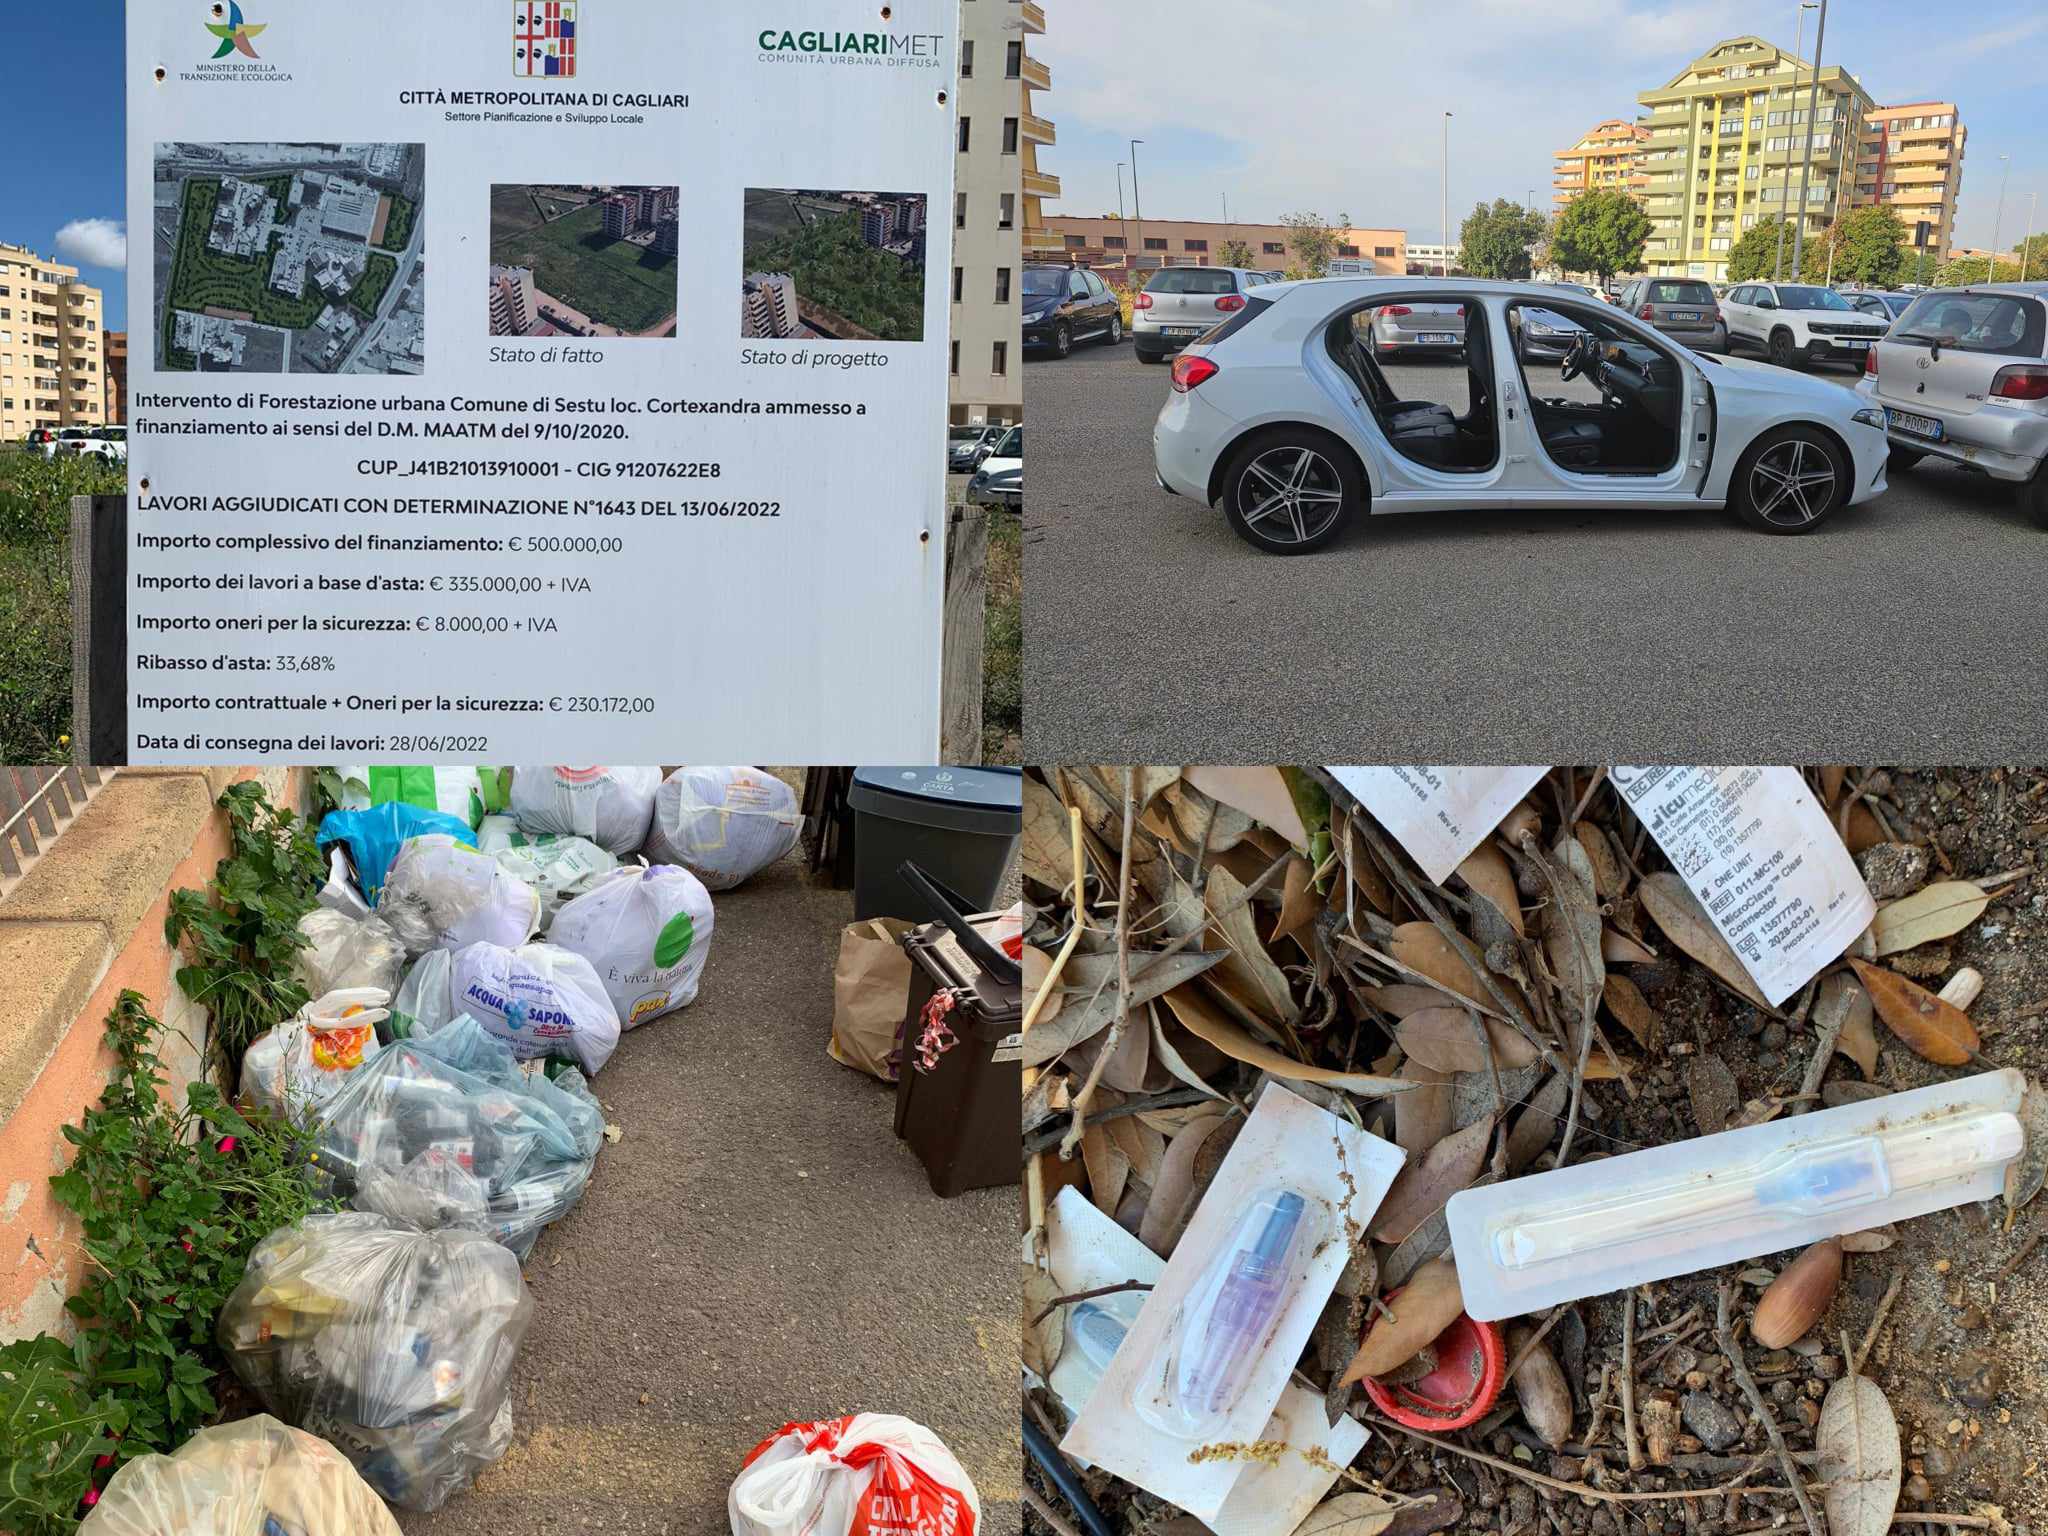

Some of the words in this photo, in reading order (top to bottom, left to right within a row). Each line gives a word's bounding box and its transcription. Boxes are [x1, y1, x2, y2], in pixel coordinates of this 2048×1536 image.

[196, 64, 245, 73] MINISTERO
[247, 64, 277, 73] DELLA
[758, 53, 825, 64] COMUNITÀ
[829, 54, 883, 66] URBANA
[886, 55, 941, 69] DIFFUSA
[180, 73, 239, 82] TRANSIZIONE
[241, 73, 293, 82] ECOLOGICA
[399, 87, 447, 105] CITTÀ
[450, 91, 589, 106] METROPOLITANA
[592, 92, 608, 107] DI
[612, 92, 689, 108] CAGLIARI
[444, 111, 481, 123] Settore
[483, 112, 554, 124] Pianificazione
[556, 114, 562, 123] e
[564, 112, 608, 127] Sviluppo
[610, 113, 645, 125] Locale
[487, 346, 536, 363] Stato
[539, 346, 558, 363] di
[561, 346, 604, 364] fatto
[740, 348, 790, 368] Stato
[791, 348, 809, 366] di
[811, 351, 889, 370] progetto
[135, 391, 233, 409] Intervento
[236, 392, 254, 409] di
[259, 393, 378, 411] Forestazione
[381, 394, 446, 412] urbana
[450, 396, 529, 413] Comune
[532, 396, 550, 413] di
[554, 396, 606, 413] Sestu
[610, 396, 643, 414] loc.
[646, 397, 761, 415] Cortexandra
[764, 402, 852, 416] ammesso
[855, 403, 867, 416] a
[135, 418, 269, 436] finanziamento
[272, 419, 288, 436] ai
[292, 420, 340, 437] sensi
[343, 420, 373, 437] del
[377, 421, 419, 438] D.M.
[423, 422, 497, 439] MAATM
[500, 422, 530, 439] del
[533, 422, 629, 441] 9/10/2020.
[357, 459, 559, 477] CUP_J41B21013910001
[576, 461, 612, 478] CIG
[615, 462, 721, 479] 91207622E8
[137, 495, 208, 512] LAVORI
[211, 496, 339, 513] AGGIUDICATI
[343, 497, 388, 514] CON
[393, 498, 569, 516] DETERMINAZIONE
[573, 499, 636, 516] N°1643
[640, 500, 678, 517] DEL
[680, 500, 781, 518] 13/06/2022
[136, 532, 212, 552] Importo
[215, 533, 330, 553] complessivo
[334, 533, 363, 551] del
[366, 534, 504, 552] finanziamento:
[508, 536, 523, 552] €
[527, 536, 624, 555] 500.000,00
[136, 573, 212, 593] Importo
[215, 573, 244, 590] dei
[248, 573, 299, 590] lavori
[302, 578, 314, 590] a
[318, 574, 362, 591] base
[365, 574, 425, 592] d'asta:
[429, 575, 444, 592] €
[448, 575, 542, 595] 335.000,00
[546, 580, 556, 590] +
[561, 577, 592, 593] IVA
[136, 613, 212, 633] Importo
[215, 614, 263, 631] oneri
[267, 618, 300, 634] per
[302, 614, 318, 631] la
[322, 615, 411, 632] sicurezza:
[415, 615, 430, 632] €
[434, 616, 509, 635] 8.000,00
[513, 620, 523, 630] +
[528, 616, 558, 633] IVA
[136, 653, 208, 671] Ribasso
[211, 654, 272, 671] d'asta:
[275, 655, 336, 674] 33,68%
[136, 693, 211, 713] Importo
[214, 694, 328, 711] contrattuale
[331, 697, 342, 708] +
[346, 694, 397, 711] Oneri
[401, 698, 433, 715] per
[436, 695, 452, 711] la
[455, 695, 544, 712] sicurezza:
[548, 696, 563, 712] €
[567, 696, 655, 715] 230.172,00
[136, 733, 179, 750] Data
[182, 733, 201, 750] di
[204, 738, 293, 754] consegna
[297, 734, 326, 751] dei
[330, 734, 385, 751] lavori:
[389, 735, 488, 753] 28/06/2022
[1713, 869, 1734, 888] ONE
[1732, 852, 1755, 873] UNIT
[1779, 854, 1805, 877] Clear
[1711, 892, 1732, 912] REF
[1733, 849, 1786, 895] 011-MC100
[1727, 894, 1778, 939] Connector
[1759, 897, 1803, 935] 13577790
[1766, 905, 1817, 948] 2028-03-01
[623, 973, 649, 984] viva
[467, 984, 504, 1011] ACQUA
